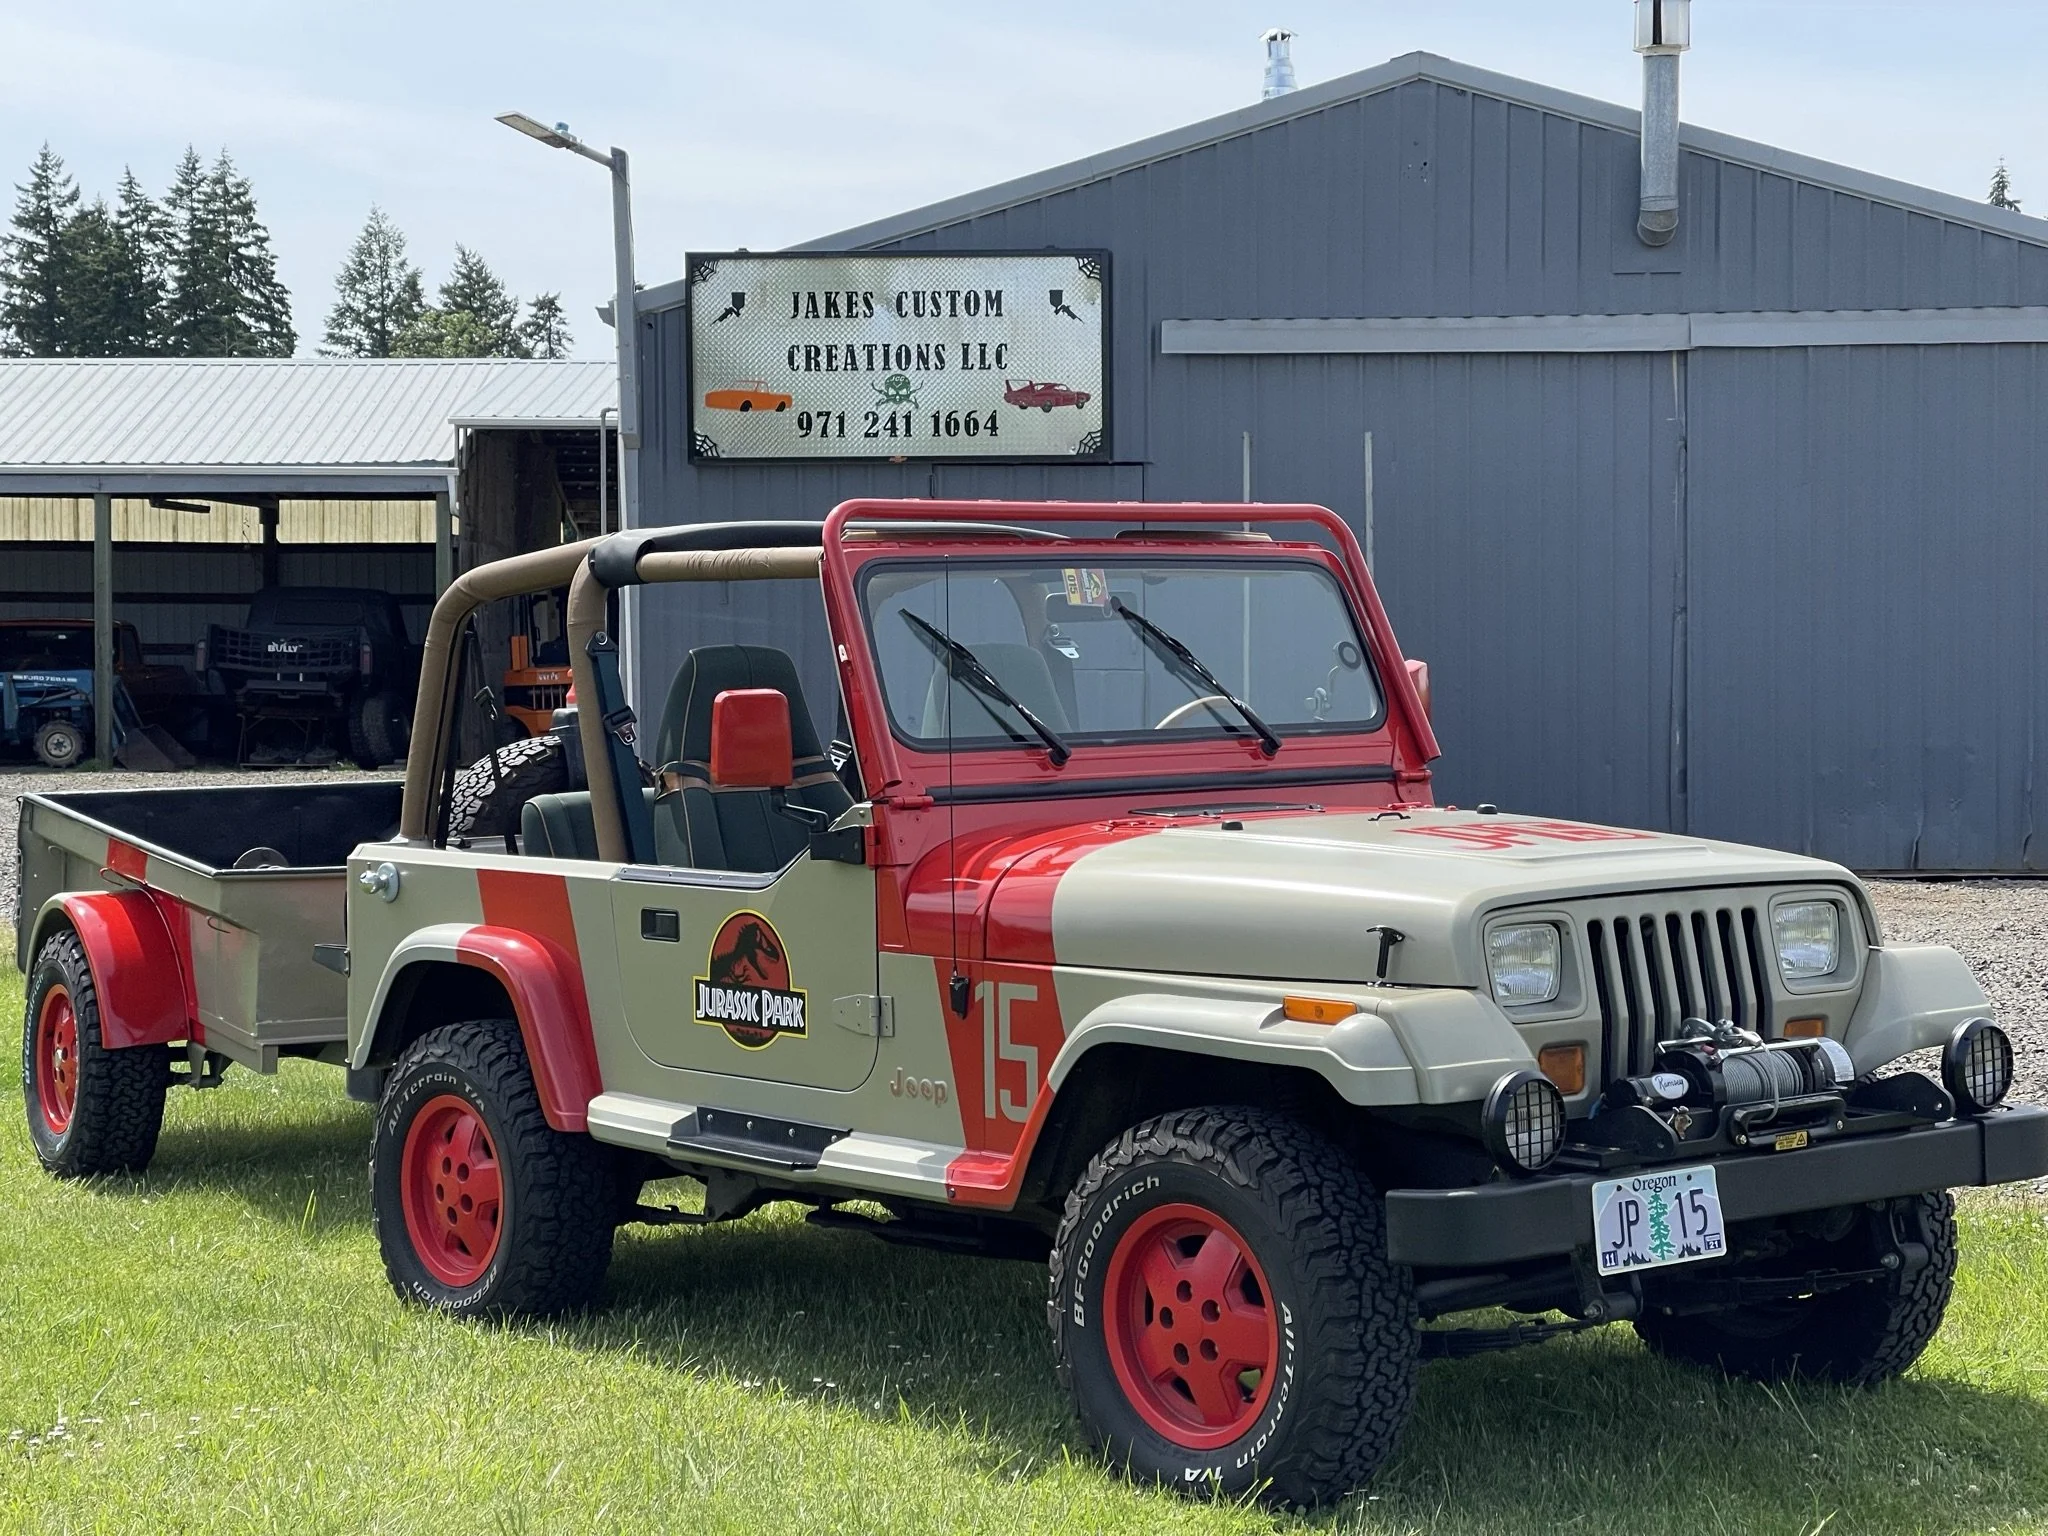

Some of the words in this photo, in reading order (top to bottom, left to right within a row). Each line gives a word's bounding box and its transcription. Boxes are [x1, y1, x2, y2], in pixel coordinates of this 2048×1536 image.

[791, 291, 874, 319] JAKES
[896, 289, 1003, 318] CUSTOM
[788, 343, 946, 371] CREATIONS
[961, 342, 1008, 370] LLC
[797, 410, 846, 438] 971
[864, 410, 913, 438] 241
[931, 409, 999, 437] 1664
[267, 641, 298, 653] BULLY
[696, 982, 760, 1023] JURASSIC
[762, 989, 804, 1028] PARK
[975, 980, 1038, 1122] 15
[388, 1072, 457, 1136] All-Terrain
[889, 1066, 949, 1108] Jeep
[1632, 1175, 1678, 1193] Oregon
[1612, 1199, 1640, 1249] JP
[1675, 1188, 1708, 1239] 15
[1073, 1175, 1160, 1327] BFGoodrich
[1605, 1255, 1616, 1267] 11
[1709, 1240, 1719, 1249] 21
[1236, 1301, 1295, 1469] All-Terrain
